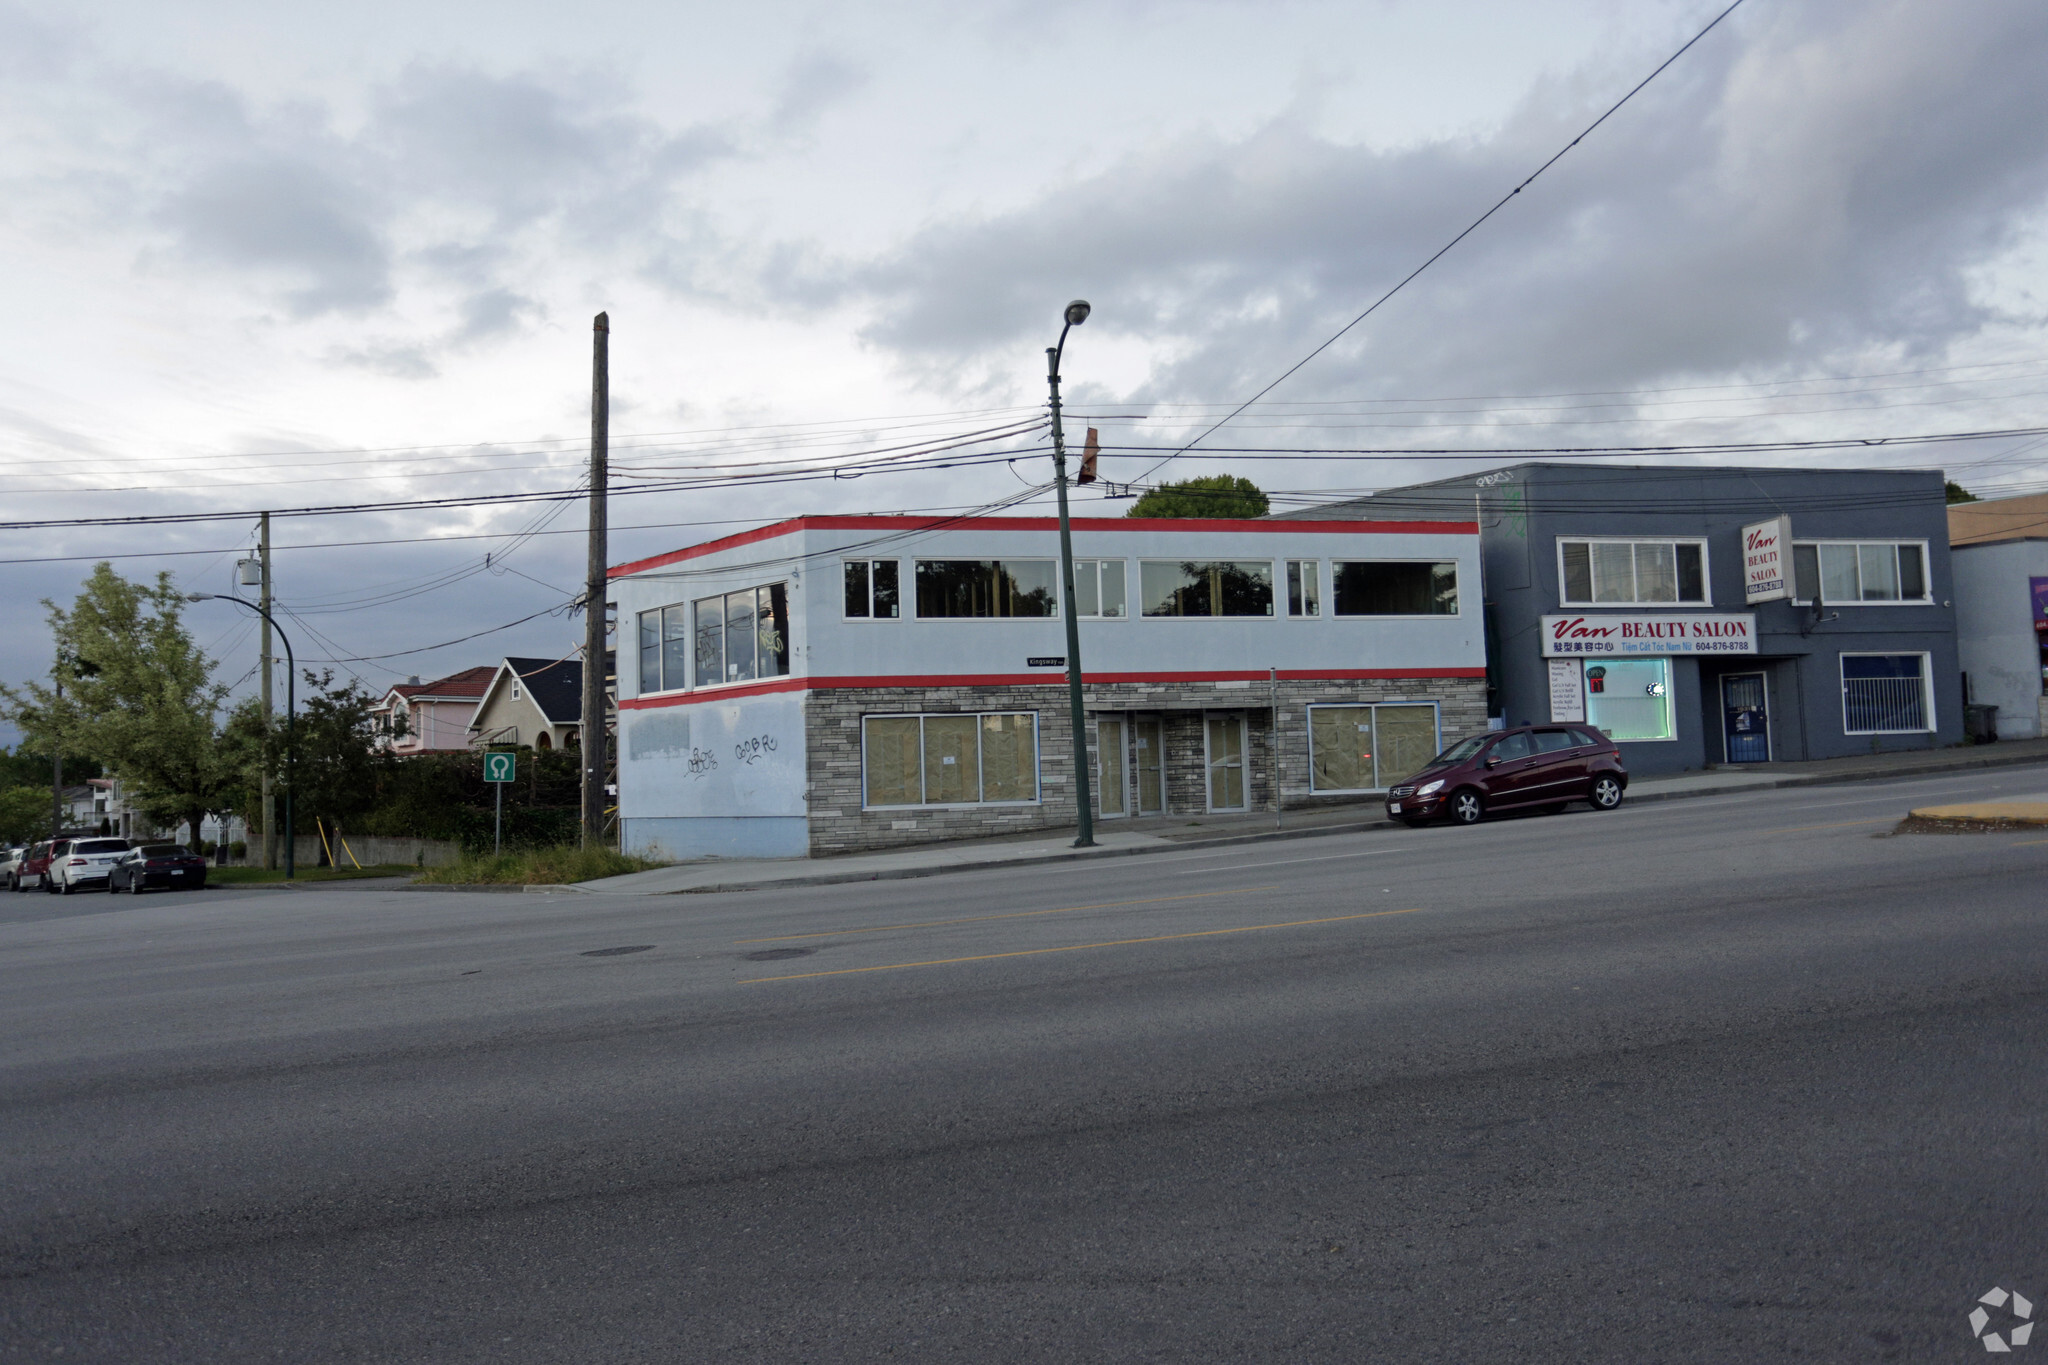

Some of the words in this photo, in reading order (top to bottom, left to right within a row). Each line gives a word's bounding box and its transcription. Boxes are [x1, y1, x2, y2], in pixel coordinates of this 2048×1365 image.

[1747, 529, 1777, 551] Van
[1748, 551, 1778, 567] BEAUTY
[1751, 568, 1777, 582] SALON
[1552, 618, 1618, 639] Van
[1621, 622, 1687, 638] BEAUTY
[1692, 622, 1747, 638] SALON
[1666, 642, 1681, 651] Nam
[1696, 641, 1749, 651] 604-876-8788
[1030, 658, 1058, 666] Kingsway
[1588, 669, 1604, 677] OPEN
